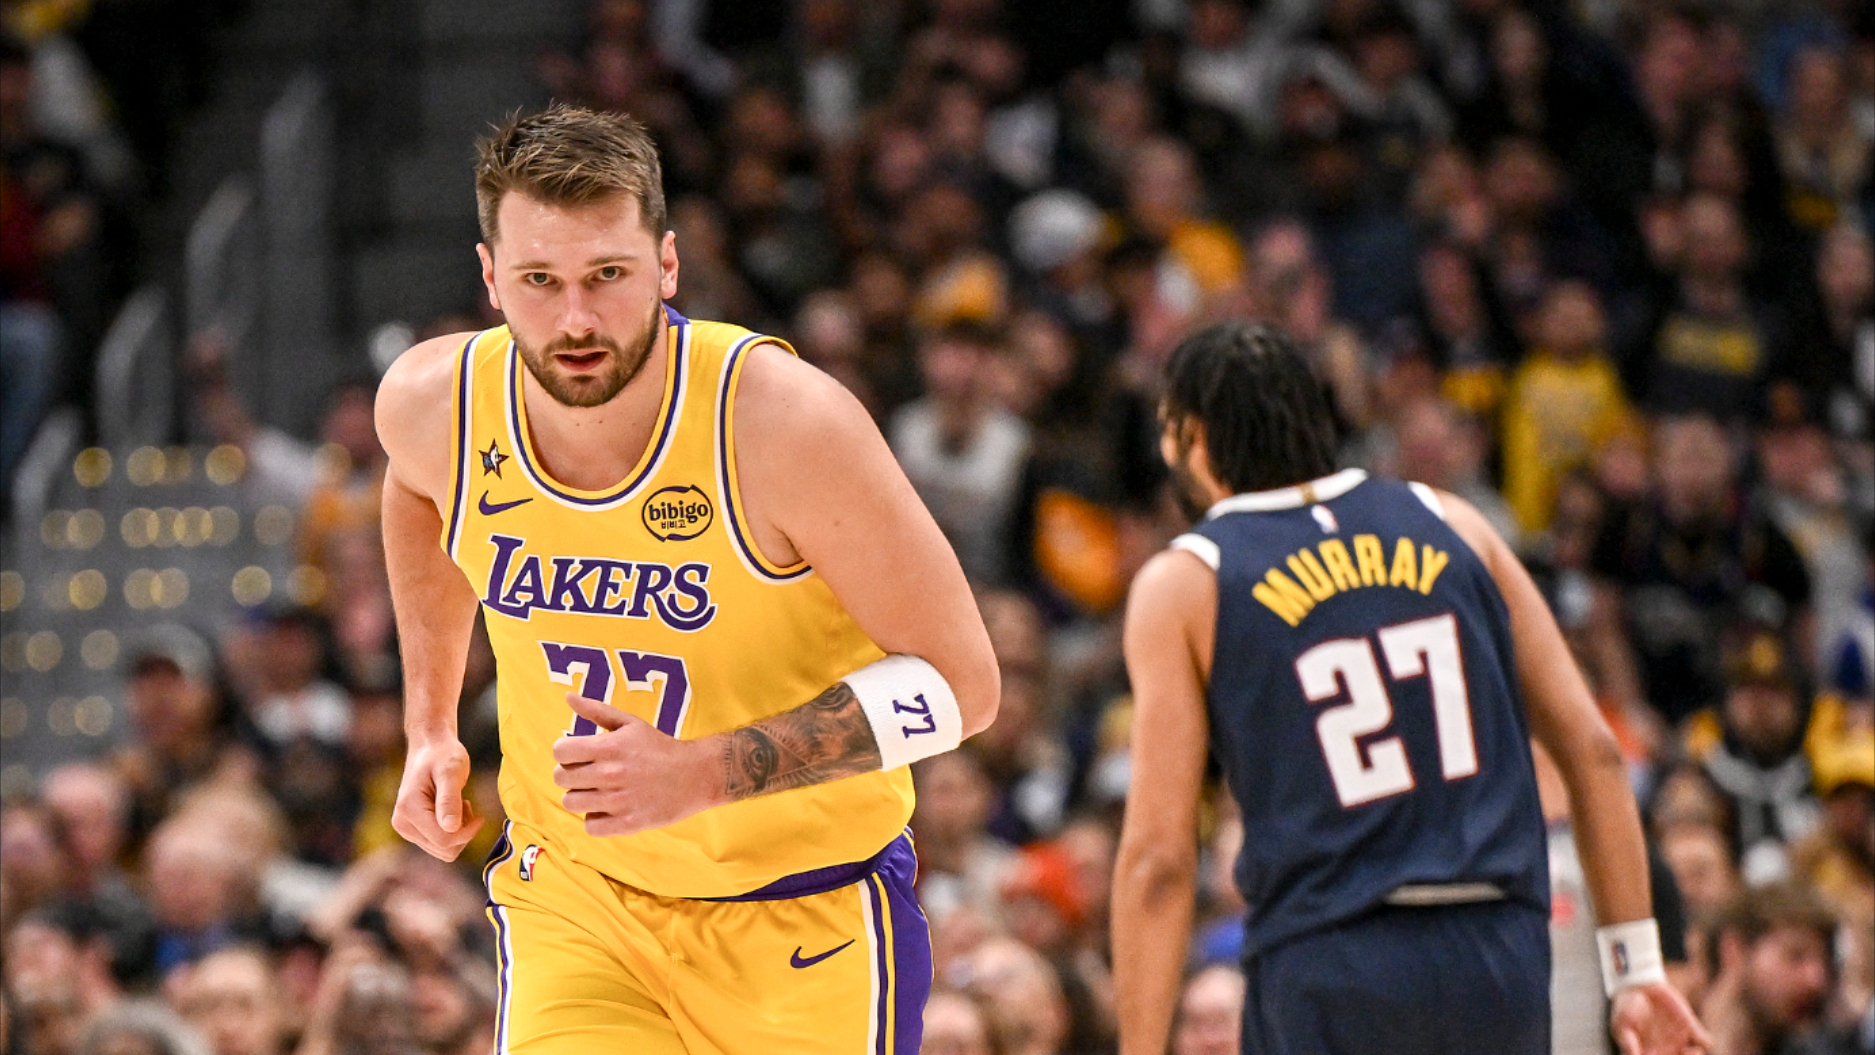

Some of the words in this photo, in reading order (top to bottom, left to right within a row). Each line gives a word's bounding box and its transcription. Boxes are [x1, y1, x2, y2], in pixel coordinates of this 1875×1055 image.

[649, 501, 708, 523] bibigo
[661, 520, 686, 529] 비비고
[482, 534, 717, 632] LAKERS
[1252, 534, 1449, 627] MURRAY
[538, 640, 692, 740] 77
[893, 694, 935, 738] 77
[1295, 613, 1479, 809] 27
